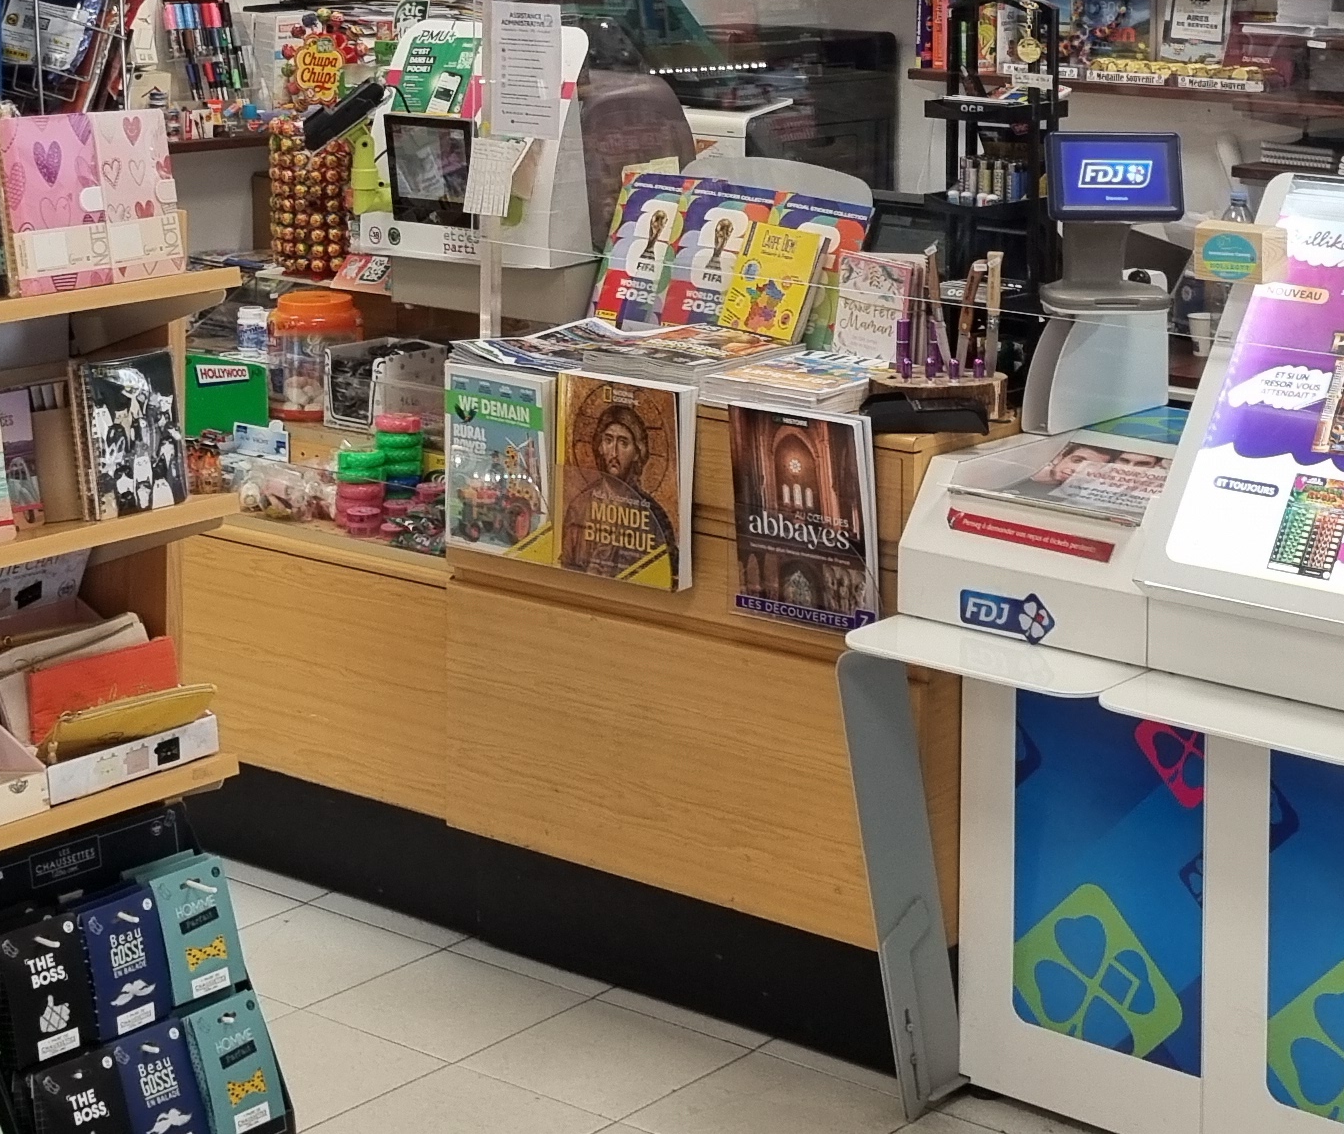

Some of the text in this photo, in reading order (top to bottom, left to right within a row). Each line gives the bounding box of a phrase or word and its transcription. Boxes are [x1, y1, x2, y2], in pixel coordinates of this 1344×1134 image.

[302, 52, 338, 71] Chupa
[301, 67, 337, 86] Chups
[1126, 74, 1155, 84] Souvenir
[1084, 165, 1124, 184] FDJ
[637, 262, 655, 272] FIFA
[839, 311, 894, 337] Maman
[200, 366, 249, 382] HOLLYWOOD
[458, 396, 530, 424] WE DEMAIN
[590, 500, 650, 530] MONDE
[584, 522, 656, 553] BIBLIQUE
[749, 511, 850, 550] abbayes
[740, 596, 850, 629] LES DÉCOUVERTES
[964, 595, 1012, 624] FDJ
[175, 895, 217, 918] HOMME
[109, 928, 142, 946] Beau
[29, 953, 56, 974] THE
[111, 942, 145, 967] GOSSE
[31, 966, 66, 989] BOSS
